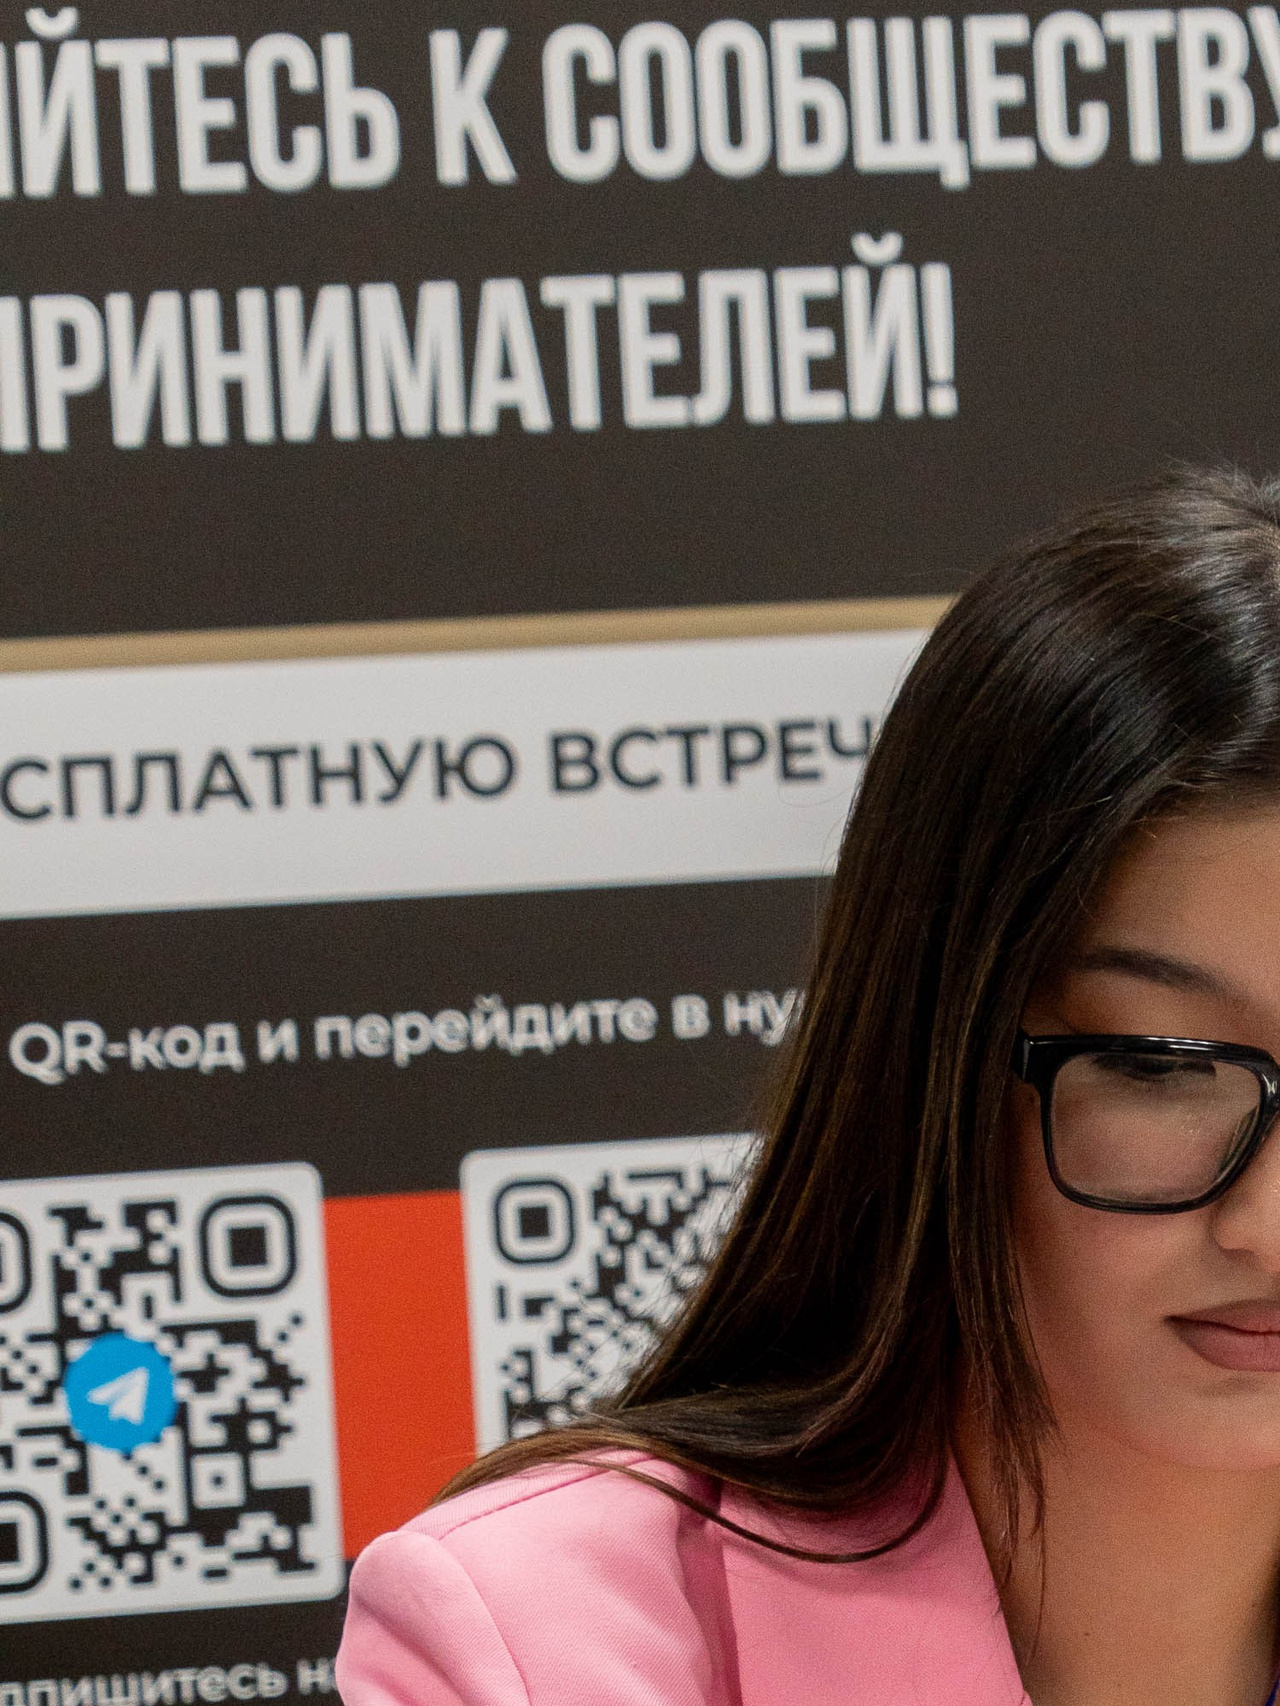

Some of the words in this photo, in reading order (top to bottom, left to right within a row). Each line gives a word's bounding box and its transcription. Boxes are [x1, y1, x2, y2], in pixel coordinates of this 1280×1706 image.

[0, 7, 400, 197] ЙТЕСЬ
[428, 28, 518, 186] К
[0, 734, 517, 822] СПЛАТНУЮ
[549, 714, 873, 796] ВСТРЕЧ
[9, 1019, 246, 1085] QR-код
[256, 1018, 299, 1063] и
[313, 993, 658, 1068] перейдите
[671, 993, 710, 1040] в
[723, 988, 806, 1046] ну
[296, 1657, 338, 1695] н
